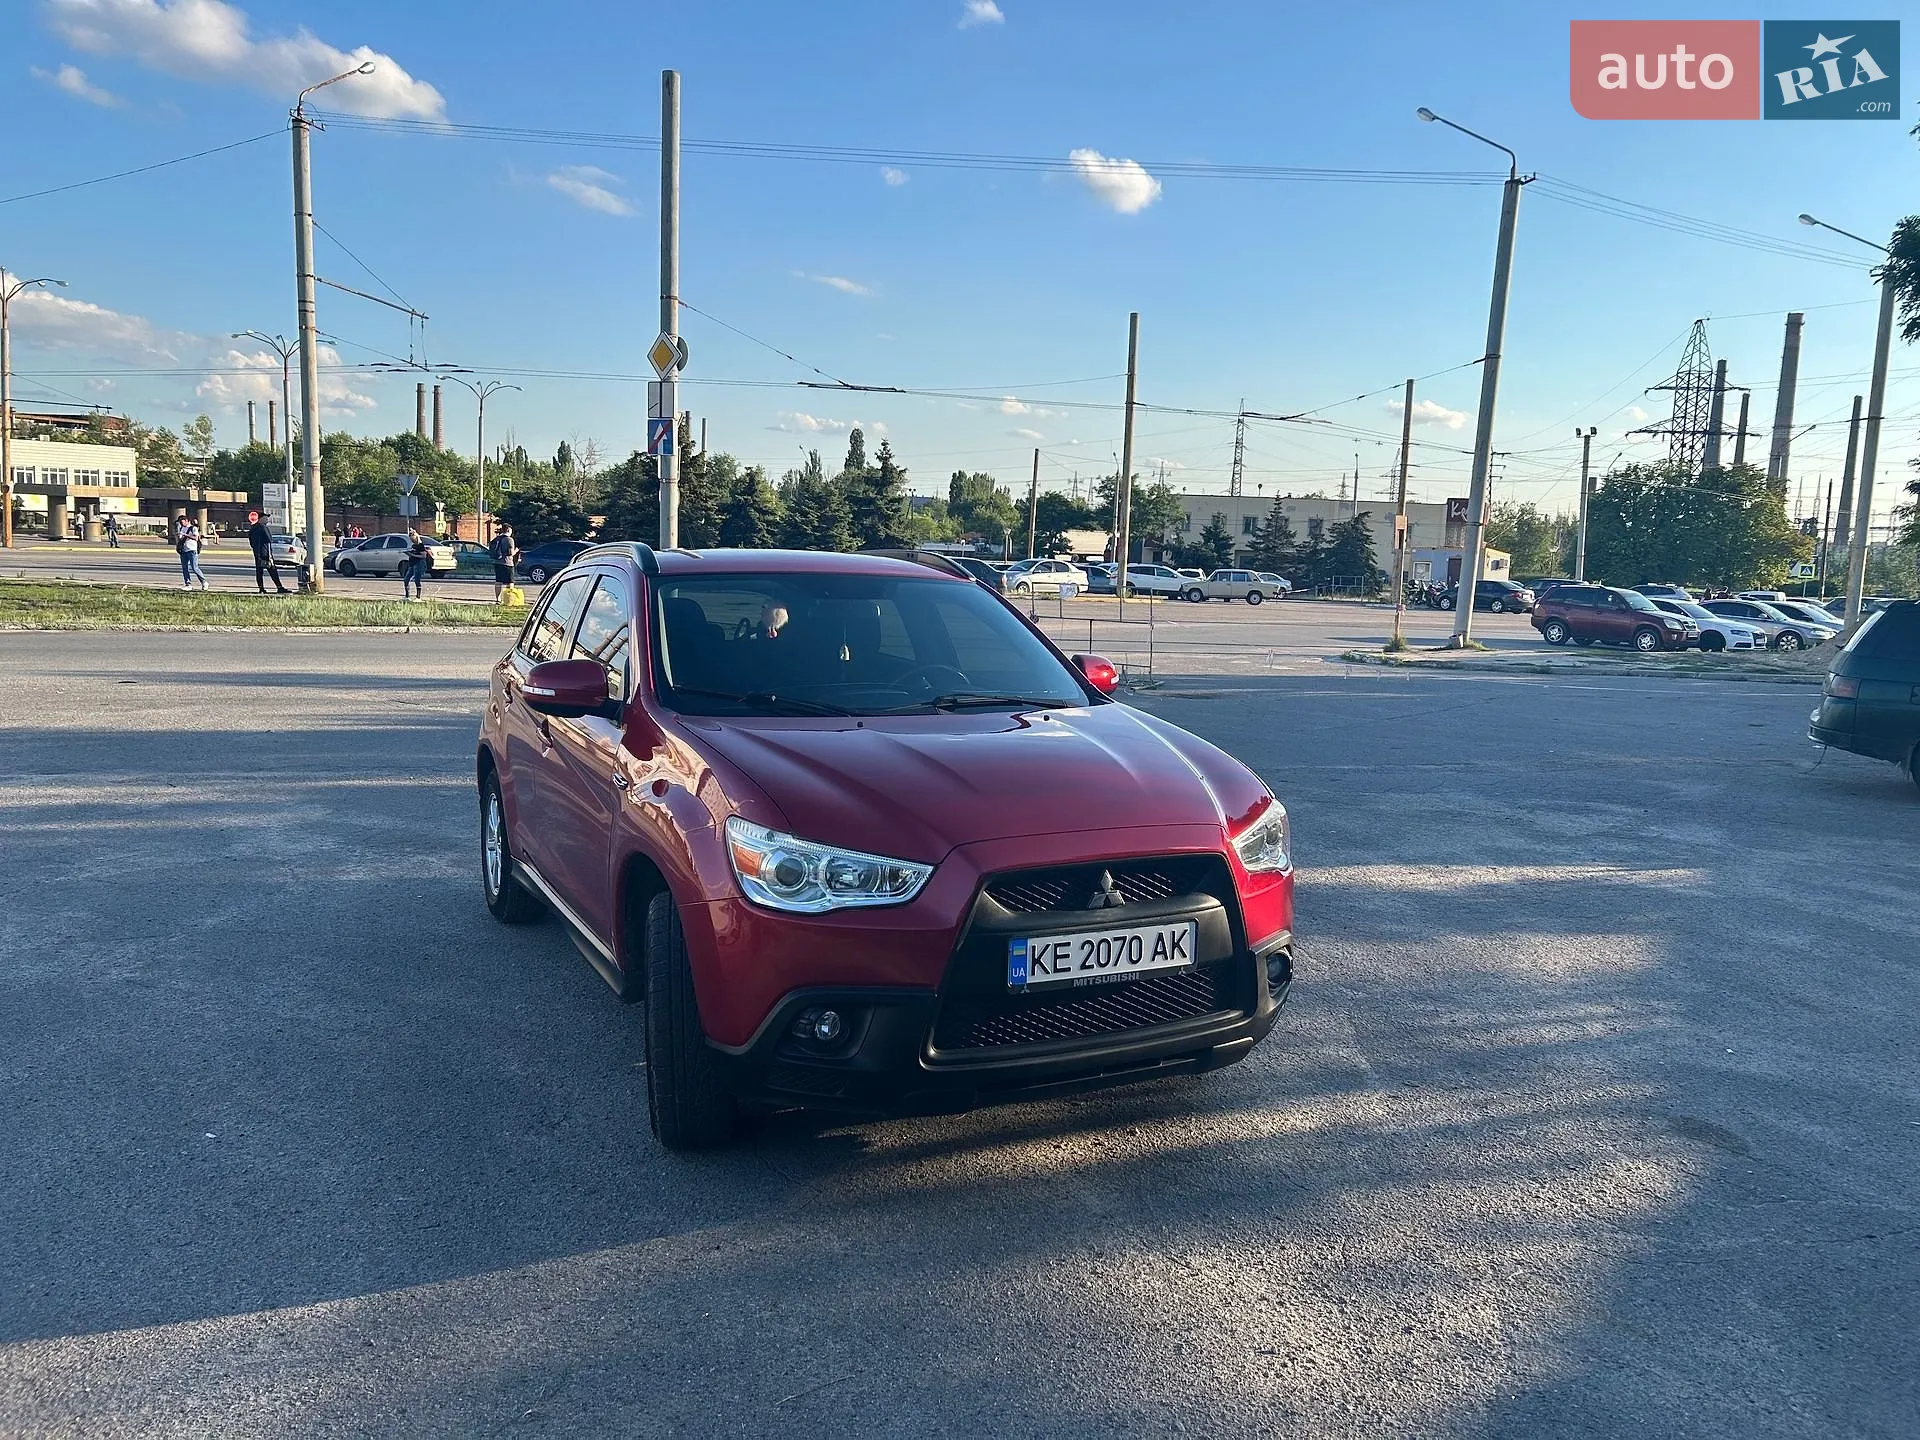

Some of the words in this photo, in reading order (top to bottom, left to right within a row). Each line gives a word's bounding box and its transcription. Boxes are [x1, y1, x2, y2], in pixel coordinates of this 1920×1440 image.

[1031, 941, 1072, 976] KE
[1080, 935, 1143, 970] 2070
[1151, 929, 1189, 962] AK
[1012, 967, 1026, 977] UA
[1073, 971, 1140, 988] MITSUBISHI
